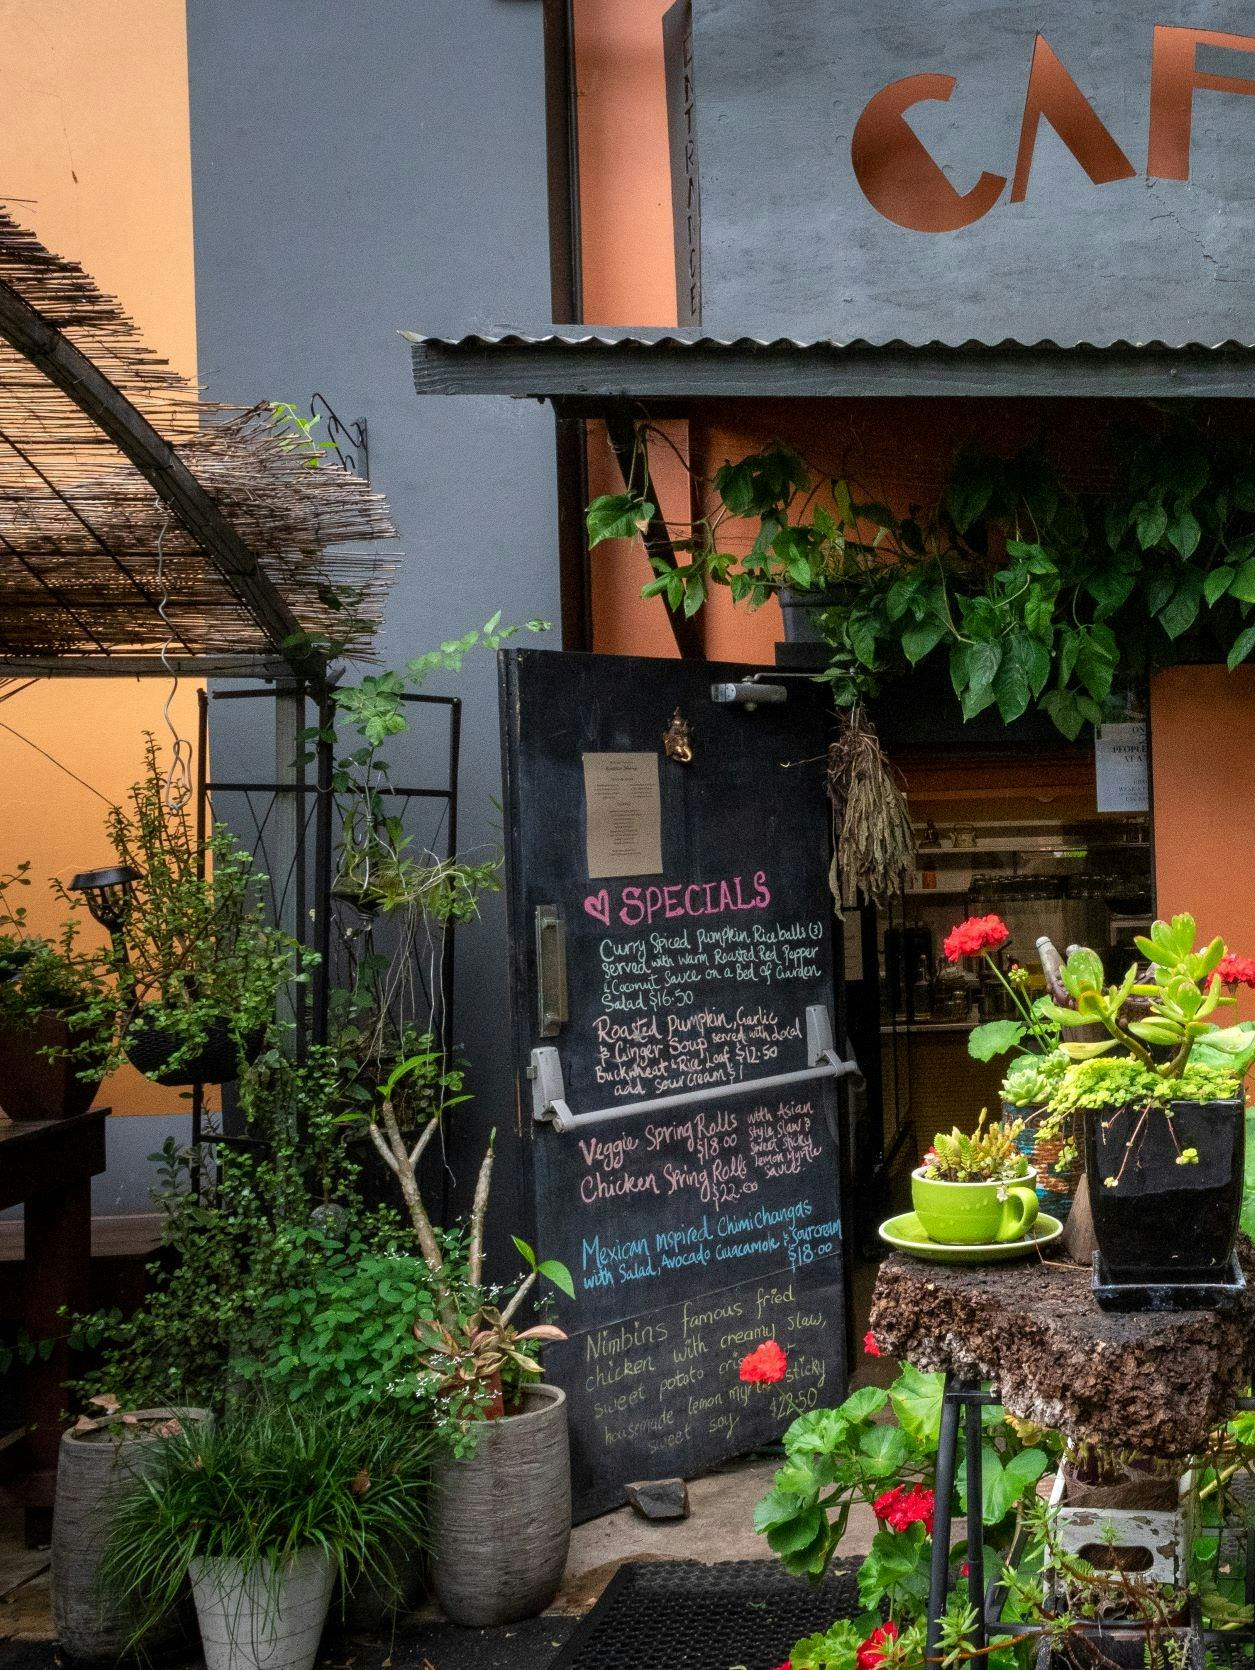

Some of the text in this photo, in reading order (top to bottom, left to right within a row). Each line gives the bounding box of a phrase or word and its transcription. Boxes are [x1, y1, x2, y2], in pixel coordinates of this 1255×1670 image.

[619, 871, 772, 926] SPECIALS
[600, 940, 647, 962] Curry
[650, 929, 691, 953] Spiced
[809, 921, 823, 940] (3)
[652, 955, 675, 967] with
[714, 948, 758, 965] Roasted
[758, 944, 782, 963] Red
[782, 944, 818, 967] Pepper
[612, 974, 661, 994] Coconut
[705, 969, 721, 979] on
[724, 967, 733, 977] a
[736, 963, 759, 980] Bed
[760, 962, 772, 984] of
[776, 964, 821, 979] Garden
[602, 992, 648, 1012] Salad
[593, 1015, 662, 1042] Roasted
[737, 1006, 778, 1026] Garlic
[595, 1058, 668, 1083] Buckwheat
[677, 1056, 702, 1071] Rice
[706, 1046, 731, 1072] Loaf
[615, 1041, 663, 1067] Ginger
[669, 1038, 707, 1058] Soup
[712, 1026, 748, 1044] served
[749, 1025, 770, 1041] with
[615, 1078, 646, 1096] add
[747, 1101, 814, 1124] with Asian
[579, 1111, 738, 1171] Veggie Spring Rolls
[581, 1154, 747, 1203] Chicken Spring Rolls
[582, 1234, 650, 1270] Mexican
[583, 1268, 615, 1290] with
[661, 1244, 711, 1268] Avocado
[716, 1230, 780, 1260] Guacamole
[586, 1285, 797, 1362] Nimbins famous fried
[585, 1356, 655, 1392] chicken
[673, 1338, 708, 1363] with
[720, 1323, 775, 1349] creamy
[660, 1366, 704, 1401] potato
[688, 1393, 722, 1415] lemon
[785, 1357, 827, 1388] sticky
[709, 1413, 741, 1439] soy
